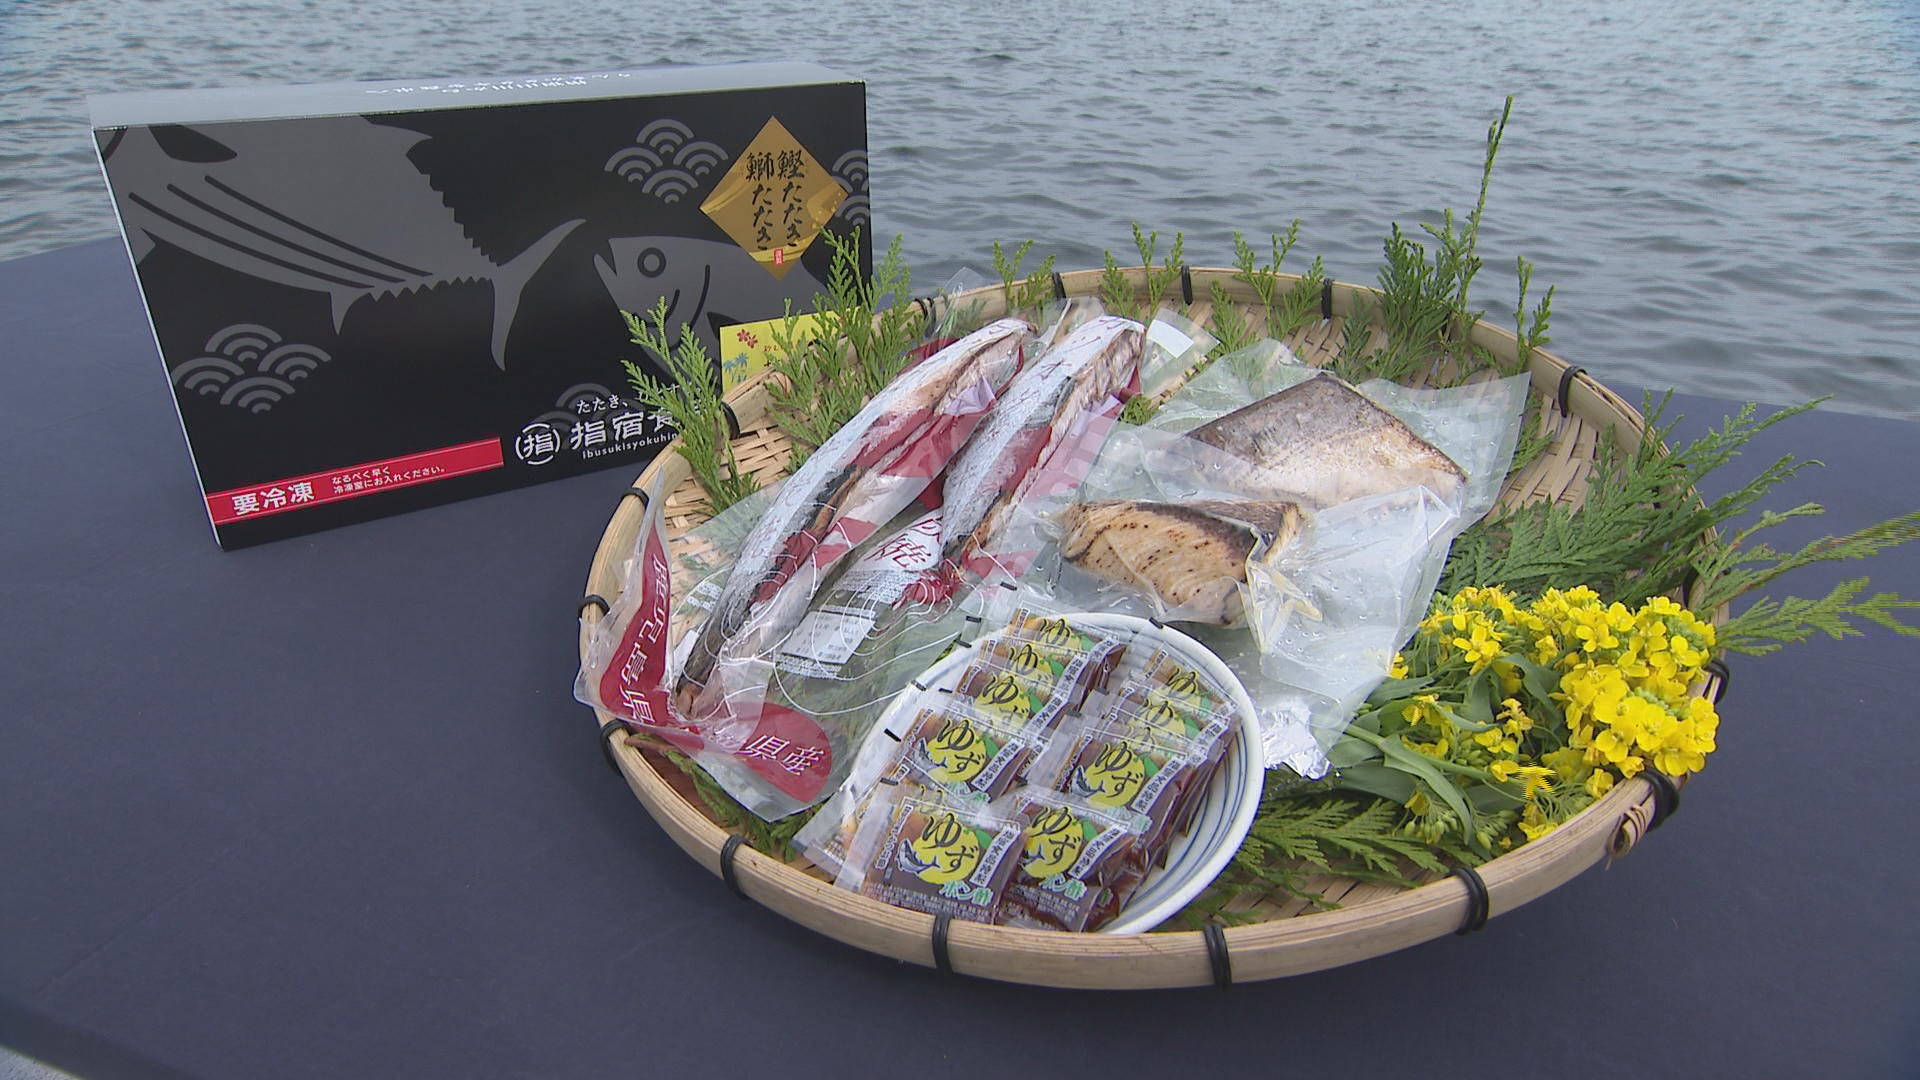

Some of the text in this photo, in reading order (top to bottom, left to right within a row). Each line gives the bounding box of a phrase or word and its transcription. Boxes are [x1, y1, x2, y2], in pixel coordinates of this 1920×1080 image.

[777, 150, 805, 247] 鰹たたき
[571, 405, 702, 450] 指宿食
[232, 481, 315, 516] 要冷凍
[332, 466, 391, 485] なるべく早く
[736, 735, 824, 776] 県産
[935, 720, 984, 774] ゆず
[1093, 742, 1143, 797] ゆず
[922, 813, 978, 873] ゆず
[1030, 807, 1081, 865] ゆず
